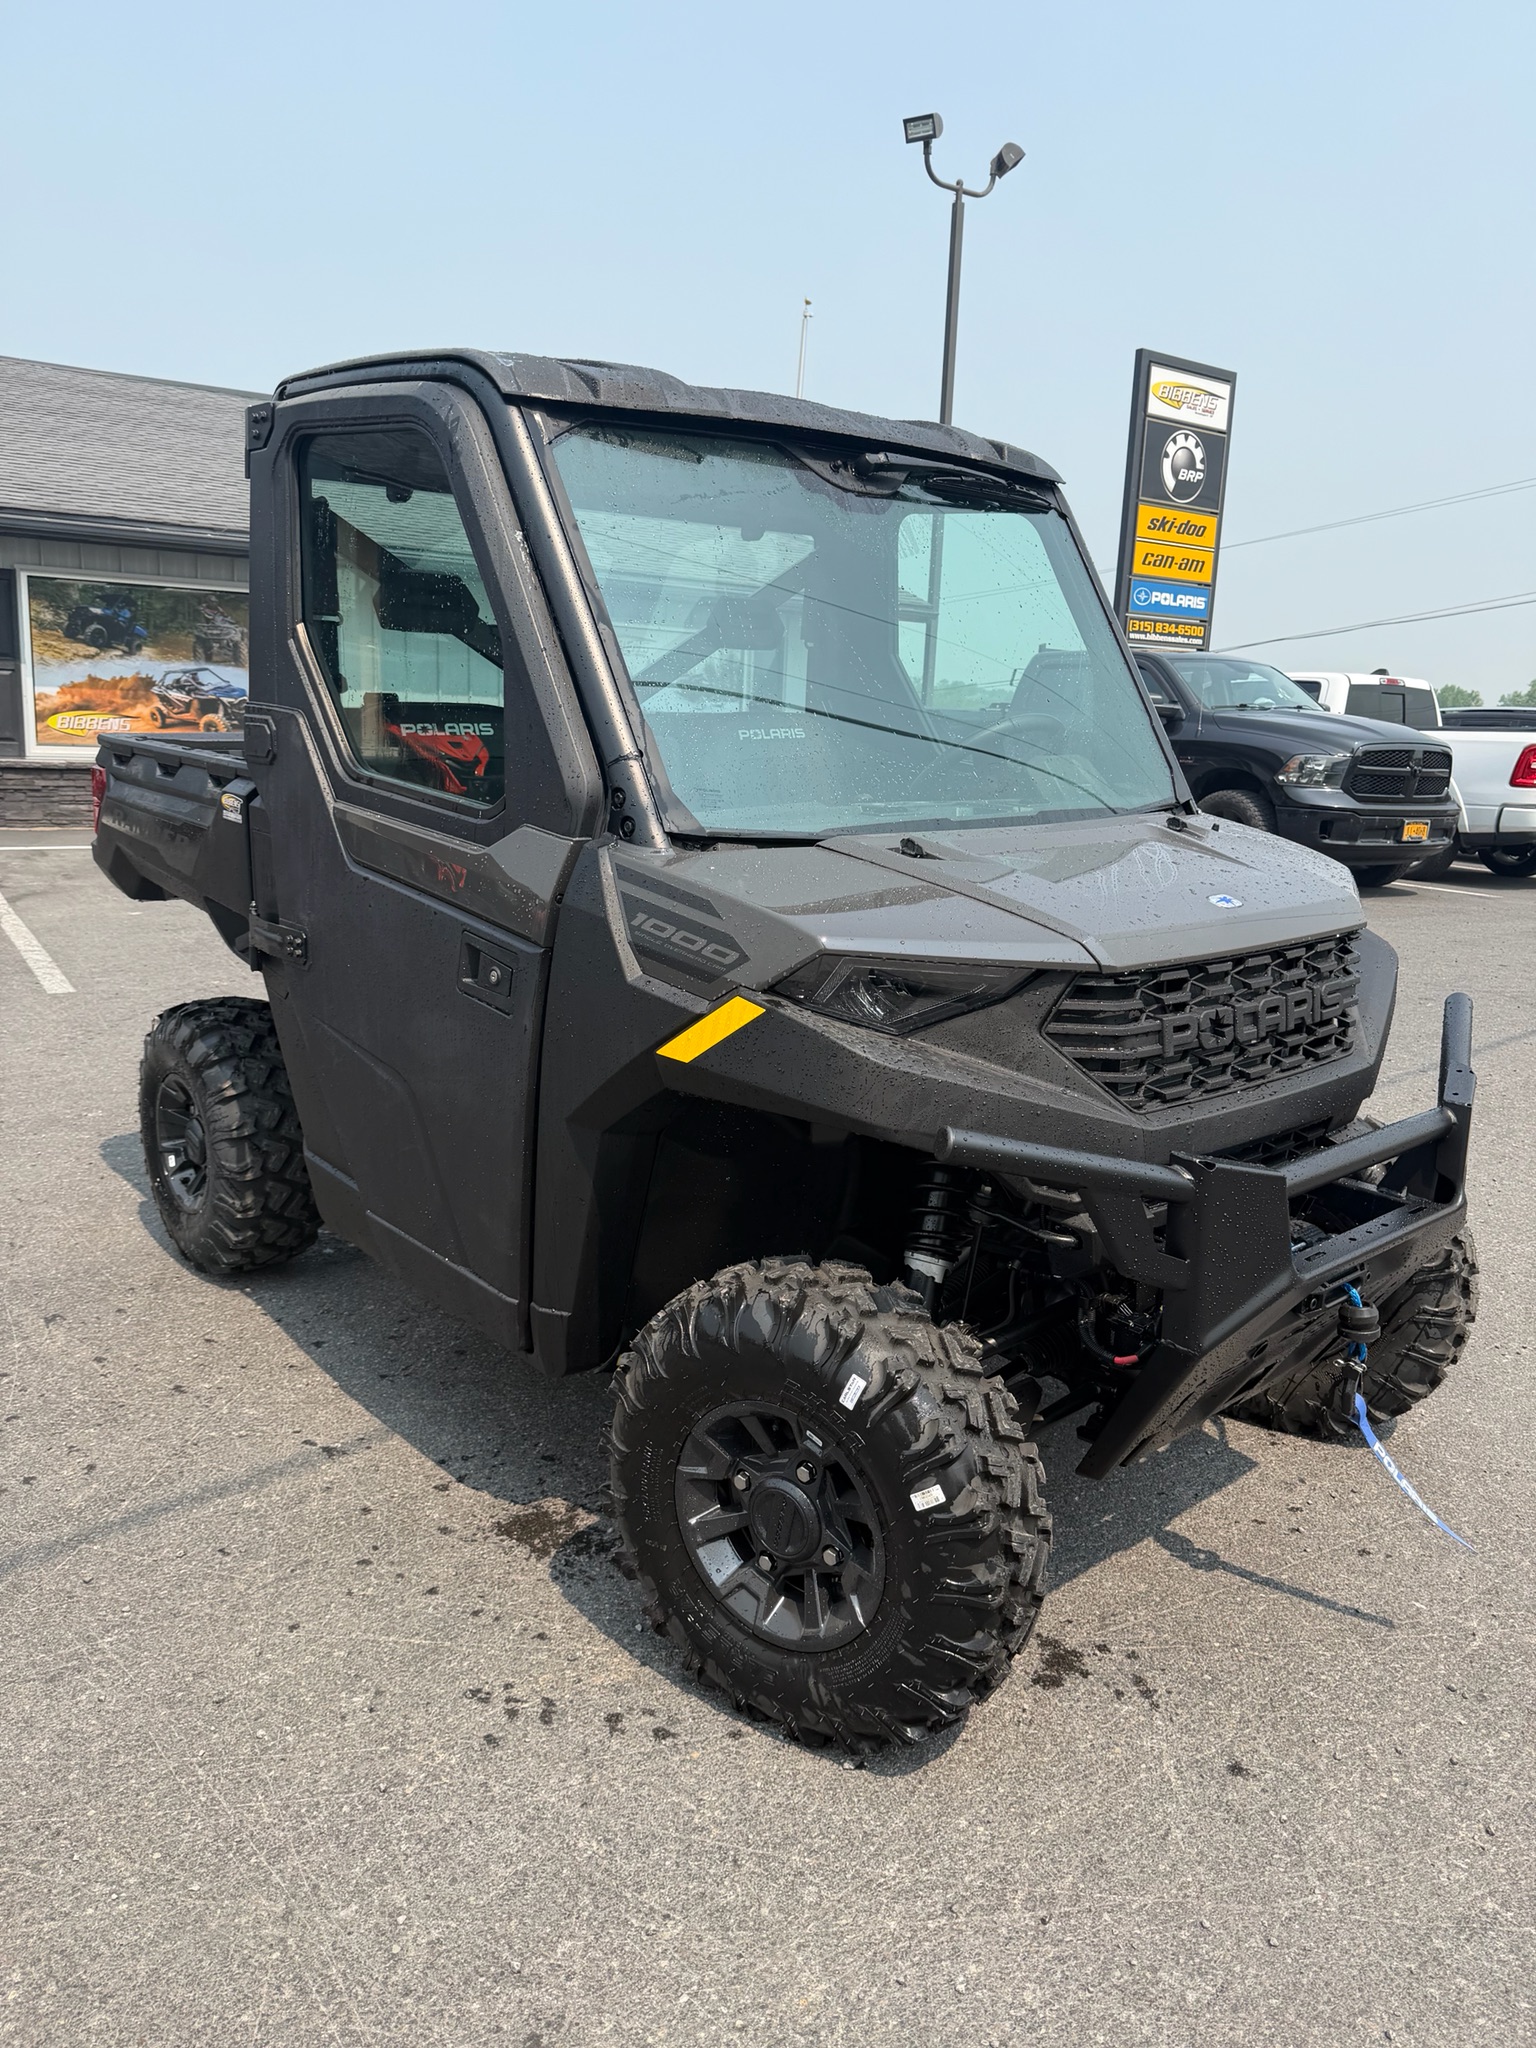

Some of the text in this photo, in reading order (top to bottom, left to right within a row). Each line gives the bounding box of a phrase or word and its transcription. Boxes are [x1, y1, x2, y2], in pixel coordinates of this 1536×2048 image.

[1159, 385, 1219, 411] BIBBENS
[1178, 468, 1204, 483] BRP
[1147, 516, 1207, 537] ski-doo
[1141, 552, 1206, 573] can-am
[1151, 591, 1207, 610] POLARIS
[1129, 619, 1205, 637] (315) 834-6500
[57, 715, 131, 731] BIBBENS
[400, 723, 495, 737] POLARIS
[738, 728, 806, 741] POLARIS
[630, 912, 740, 965] 1000
[1162, 976, 1357, 1058] POLARIS
